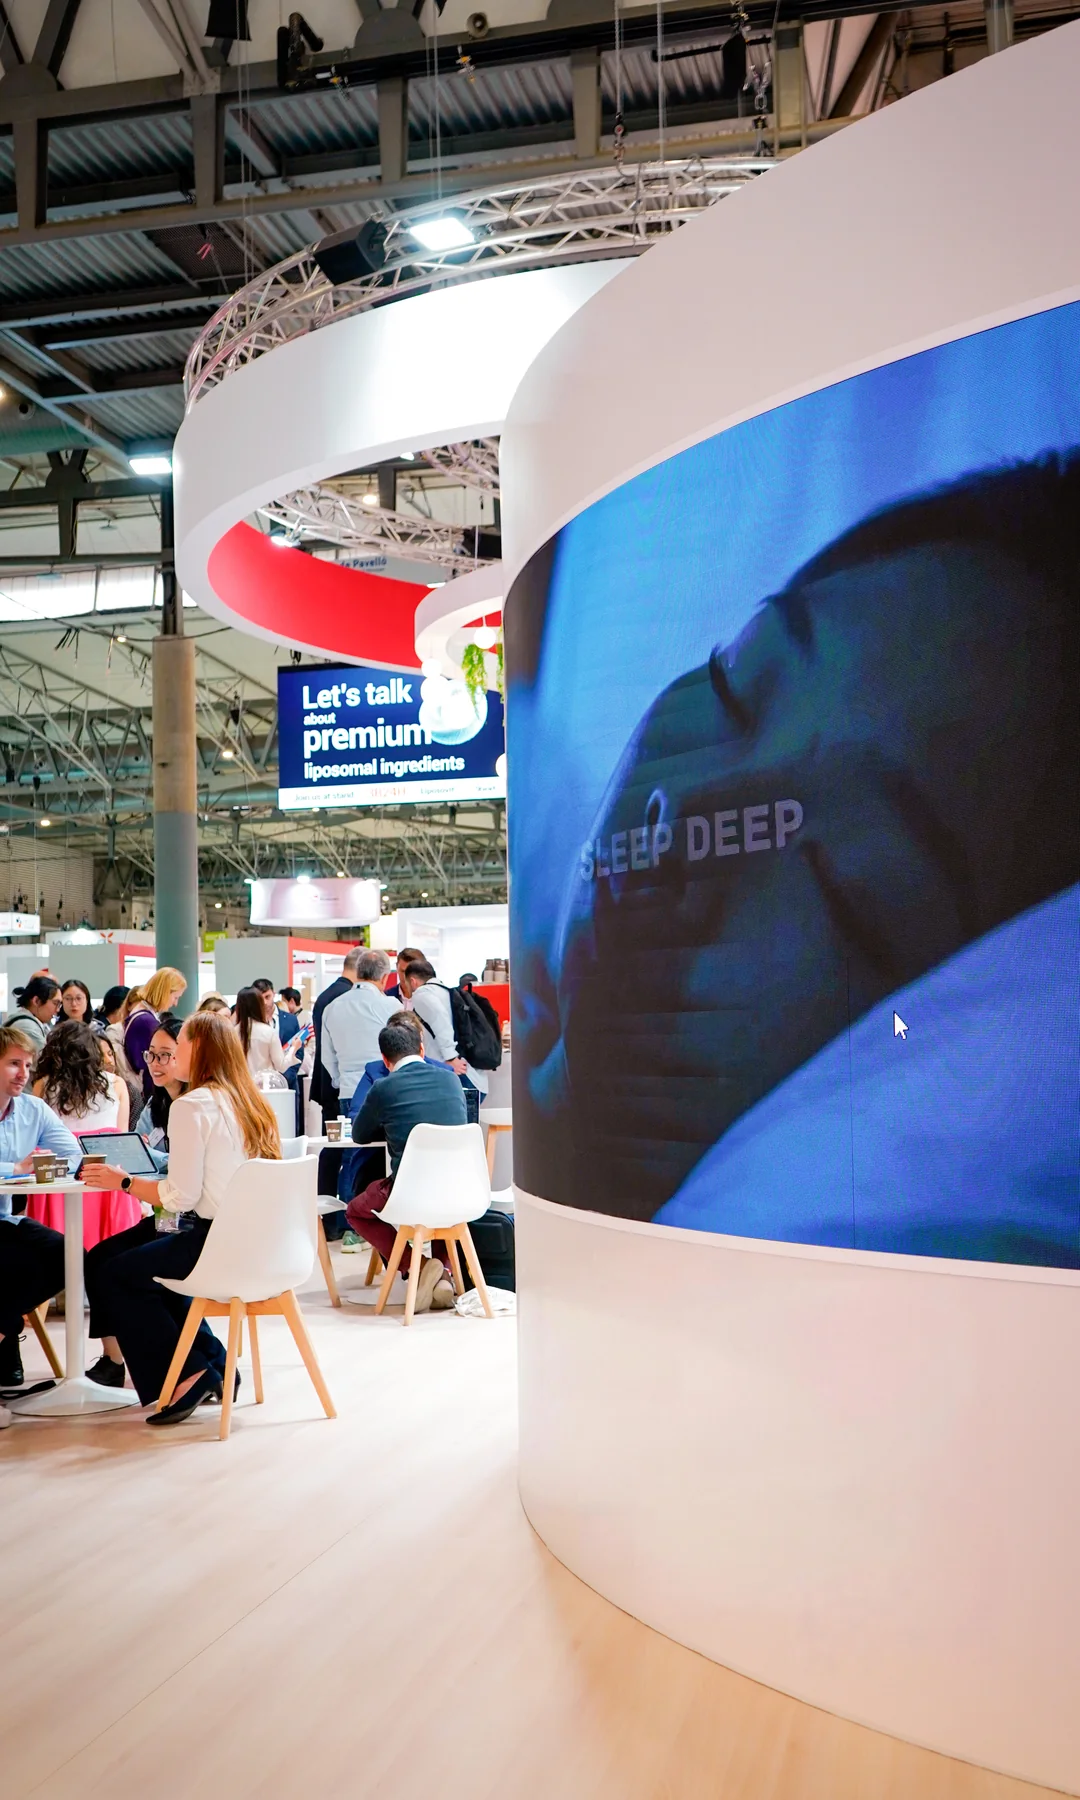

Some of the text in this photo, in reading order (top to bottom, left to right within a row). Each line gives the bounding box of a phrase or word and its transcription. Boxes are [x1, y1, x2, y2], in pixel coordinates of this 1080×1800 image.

[303, 677, 413, 710] Let's talk
[304, 712, 336, 726] about
[303, 718, 433, 759] premium
[304, 755, 466, 782] liposomal ingredients
[580, 799, 803, 881] SLEEP DEEP
